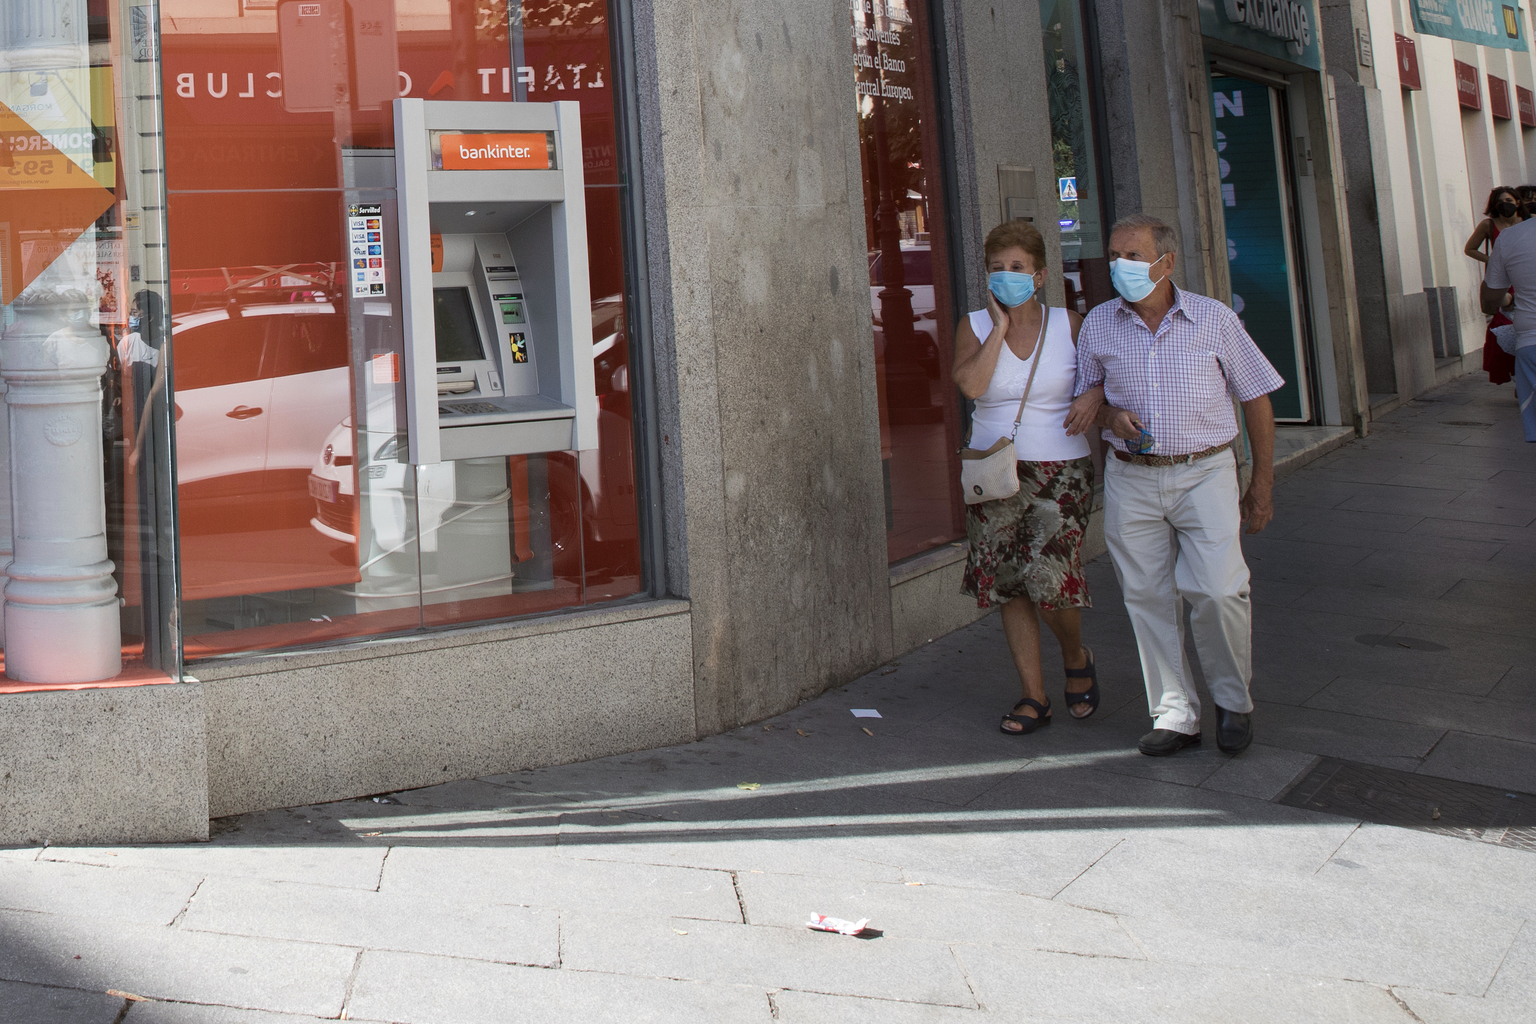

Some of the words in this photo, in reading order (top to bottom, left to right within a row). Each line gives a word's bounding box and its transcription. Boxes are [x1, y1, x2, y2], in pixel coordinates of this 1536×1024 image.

[864, 23, 901, 46] solventes
[853, 47, 873, 72] egún
[874, 52, 881, 69] el
[882, 53, 906, 73] Banco
[855, 78, 880, 97] entral
[881, 79, 914, 104] Europeo.
[460, 144, 531, 161] bankinter.
